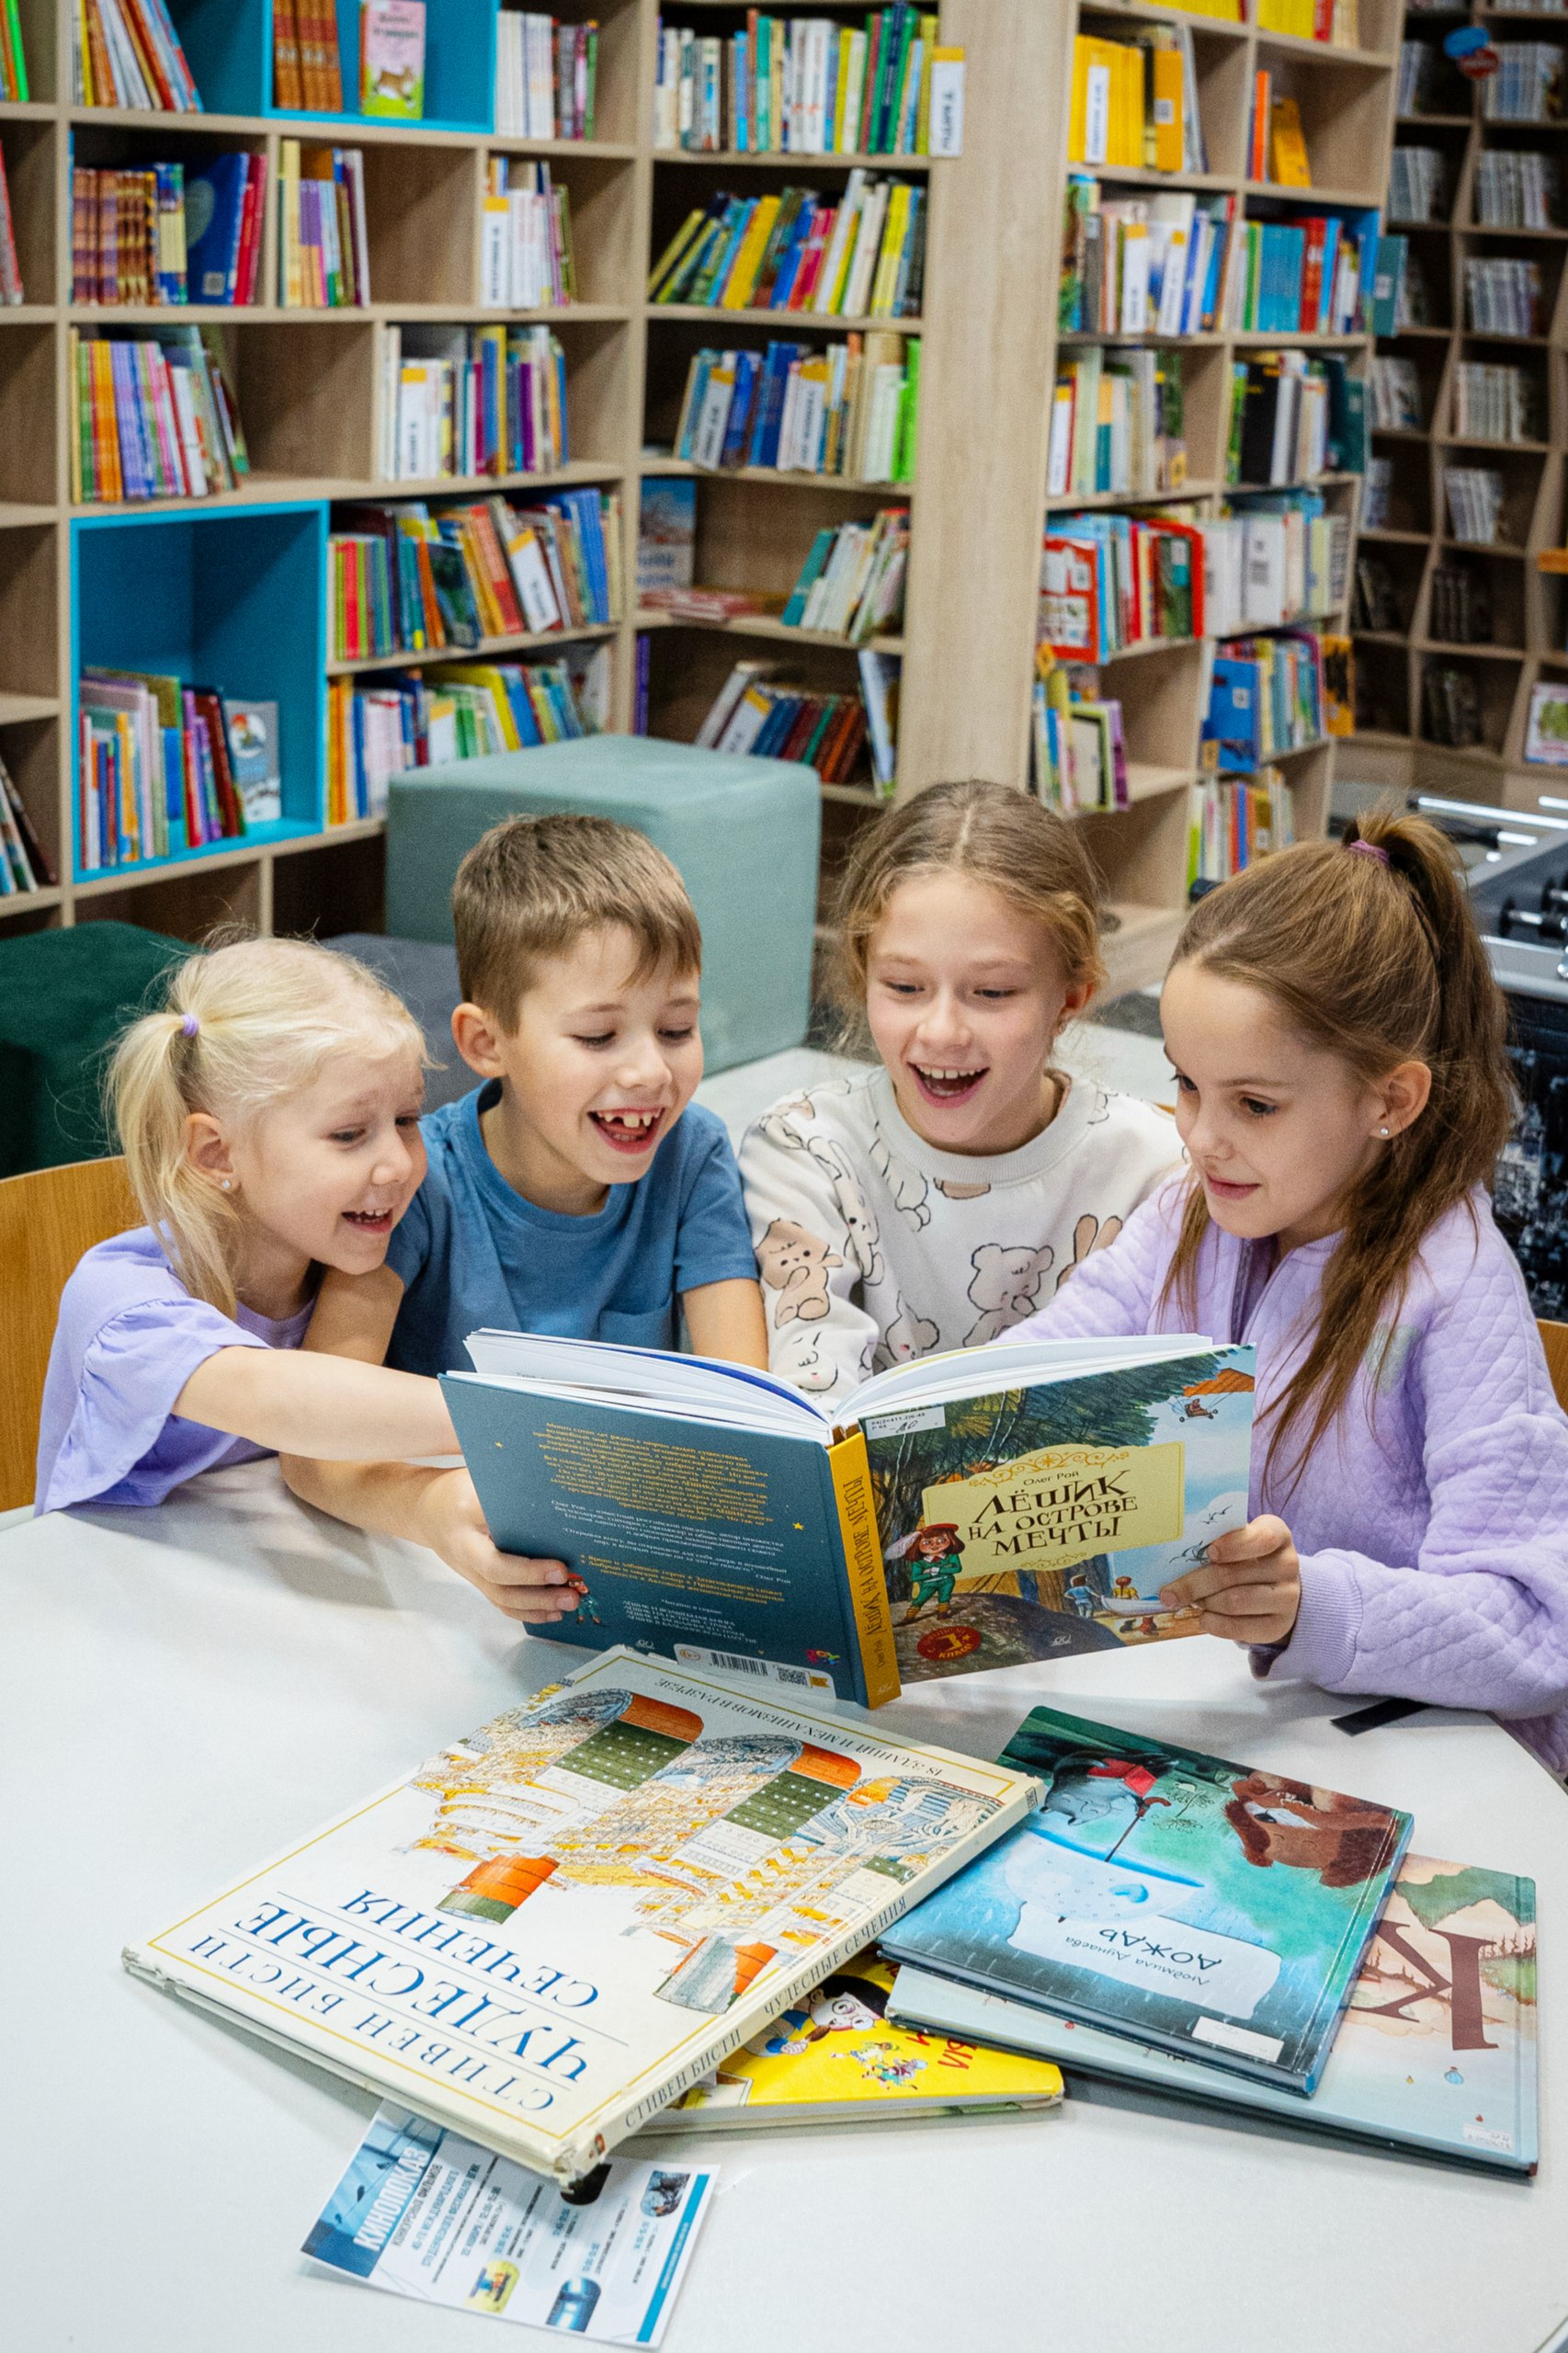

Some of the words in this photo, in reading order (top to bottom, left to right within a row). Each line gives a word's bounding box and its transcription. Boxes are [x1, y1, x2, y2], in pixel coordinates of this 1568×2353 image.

[844, 1475, 869, 1525] МЕЧТЫ
[974, 1470, 1131, 1524] ЛЁШИК
[1023, 1476, 1054, 1486] Олег
[1056, 1470, 1079, 1483] Рой
[969, 1521, 996, 1541] НА
[1015, 1496, 1138, 1530] ОСТРОВЕ
[991, 1518, 1121, 1556] МЕЧТЫ
[853, 1525, 875, 1575] ОСТРОВЕ
[861, 1575, 879, 1596] НА
[863, 1593, 887, 1635] ЛЁШИК
[653, 1677, 722, 1704] РАЗРЕЗЕ
[731, 1704, 839, 1744] МЕХАНИЗМОВ
[856, 1743, 926, 1770] ЗДАНИЙ
[340, 1889, 599, 2007] СЕЧЕНИЯ
[1065, 1937, 1131, 1961] Дунаева
[1098, 1928, 1221, 1971] ДОЖДЬ
[189, 1935, 345, 2016] БИСТИ
[234, 1902, 587, 2083] ЧУДЕСНЫЕ
[1135, 1959, 1210, 1985] Людмила
[625, 2072, 689, 2129] СТИВЕН
[690, 2029, 742, 2079] БИСТИ
[765, 1948, 841, 2017] ЧУДЕСНЫЕ
[845, 1895, 908, 1957] СЕЧЕНИЯ
[355, 2013, 554, 2111] СТИВЕН
[353, 2147, 428, 2251] КИНОПОКАЗ
[392, 2199, 424, 2245] КОНКУРСНЫХ
[417, 2164, 442, 2198] ФИЛЬМОВ
